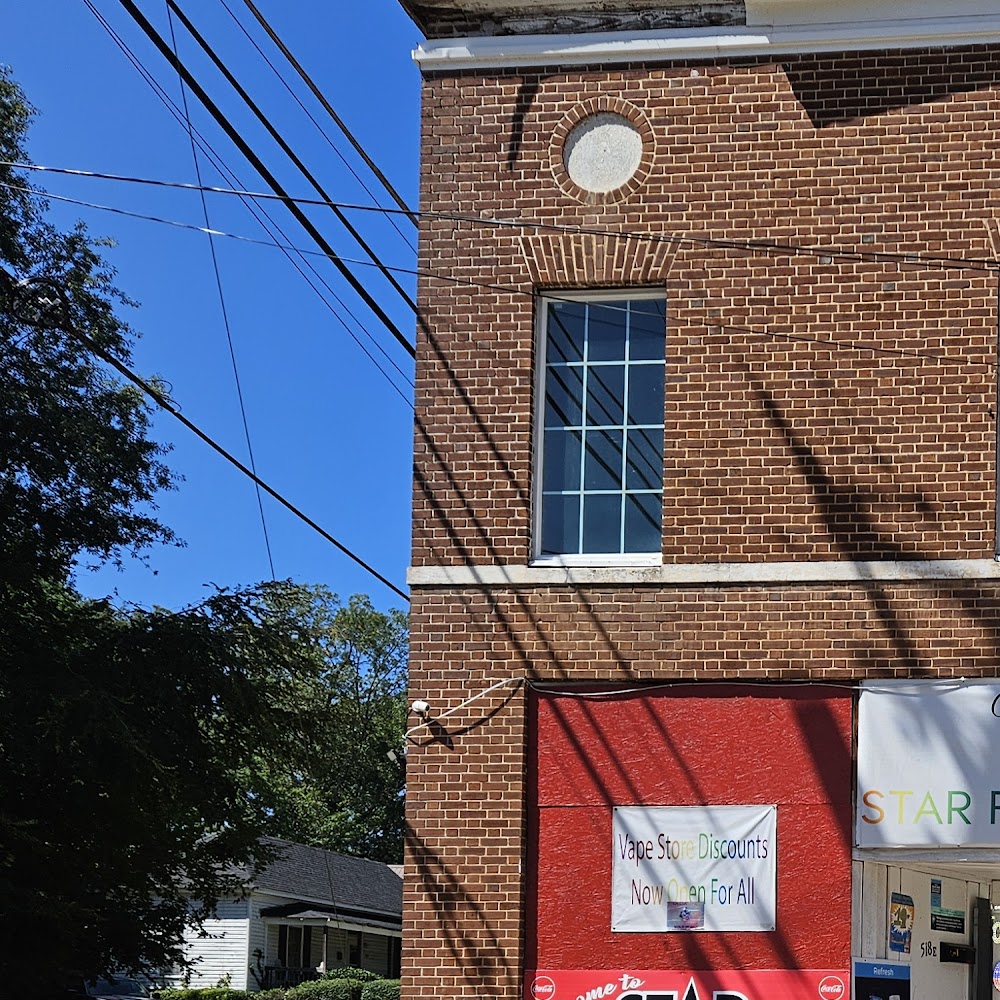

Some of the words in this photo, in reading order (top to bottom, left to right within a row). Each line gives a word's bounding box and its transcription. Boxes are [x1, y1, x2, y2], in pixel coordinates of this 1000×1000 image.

[861, 790, 972, 825] STAR
[618, 833, 654, 867] Vape
[657, 833, 694, 860] Store
[699, 833, 768, 860] Discounts
[631, 879, 664, 905] Now
[711, 878, 733, 905] For
[737, 877, 755, 905] All
[920, 941, 937, 958] 518E
[617, 974, 645, 990] to
[873, 967, 894, 976] Refresh
